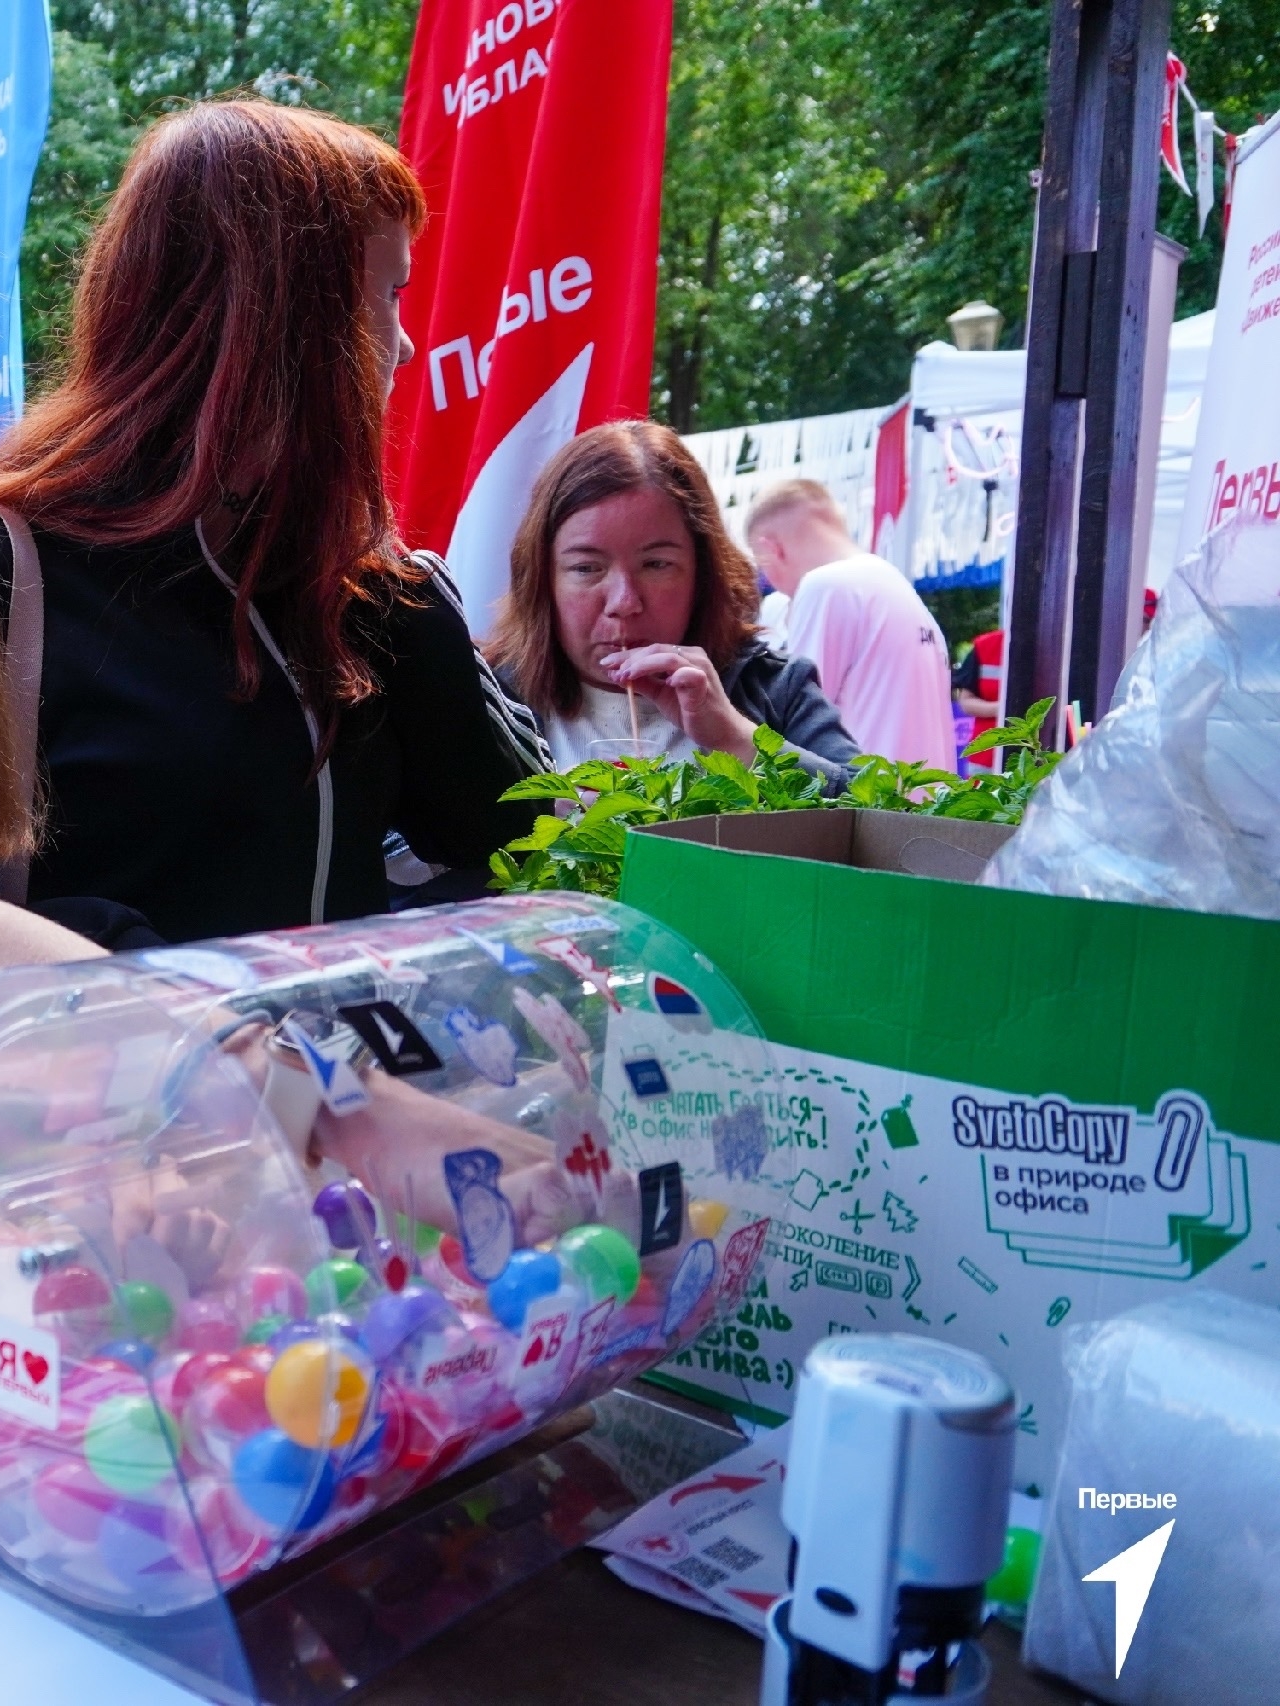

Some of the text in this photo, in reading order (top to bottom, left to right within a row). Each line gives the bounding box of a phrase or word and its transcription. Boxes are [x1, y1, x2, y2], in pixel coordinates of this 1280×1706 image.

[457, 37, 556, 130] БЛА
[952, 1095, 1130, 1165] SvetoCopy
[993, 1164, 1147, 1195] в природе
[994, 1188, 1090, 1214] офиса
